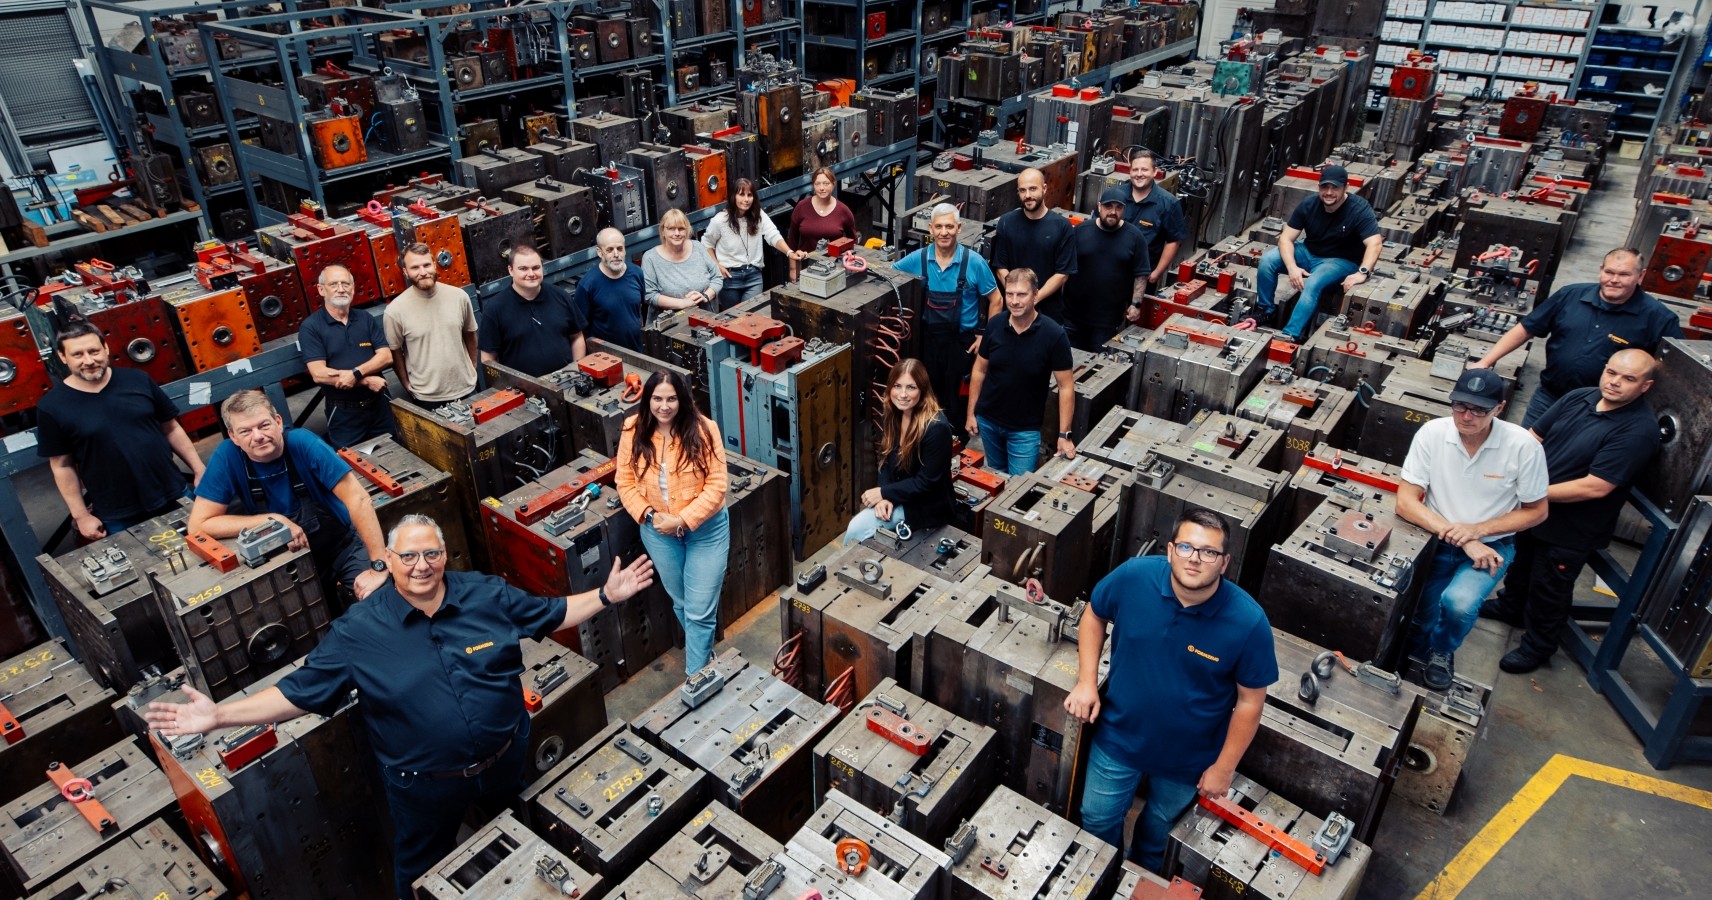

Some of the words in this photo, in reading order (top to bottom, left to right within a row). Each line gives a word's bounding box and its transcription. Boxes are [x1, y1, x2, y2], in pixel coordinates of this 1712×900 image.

[1286, 436, 1311, 452] 3038
[993, 518, 1017, 537] 3142
[187, 584, 222, 607] 3159
[793, 599, 811, 614] 2793
[602, 767, 644, 801] 2753
